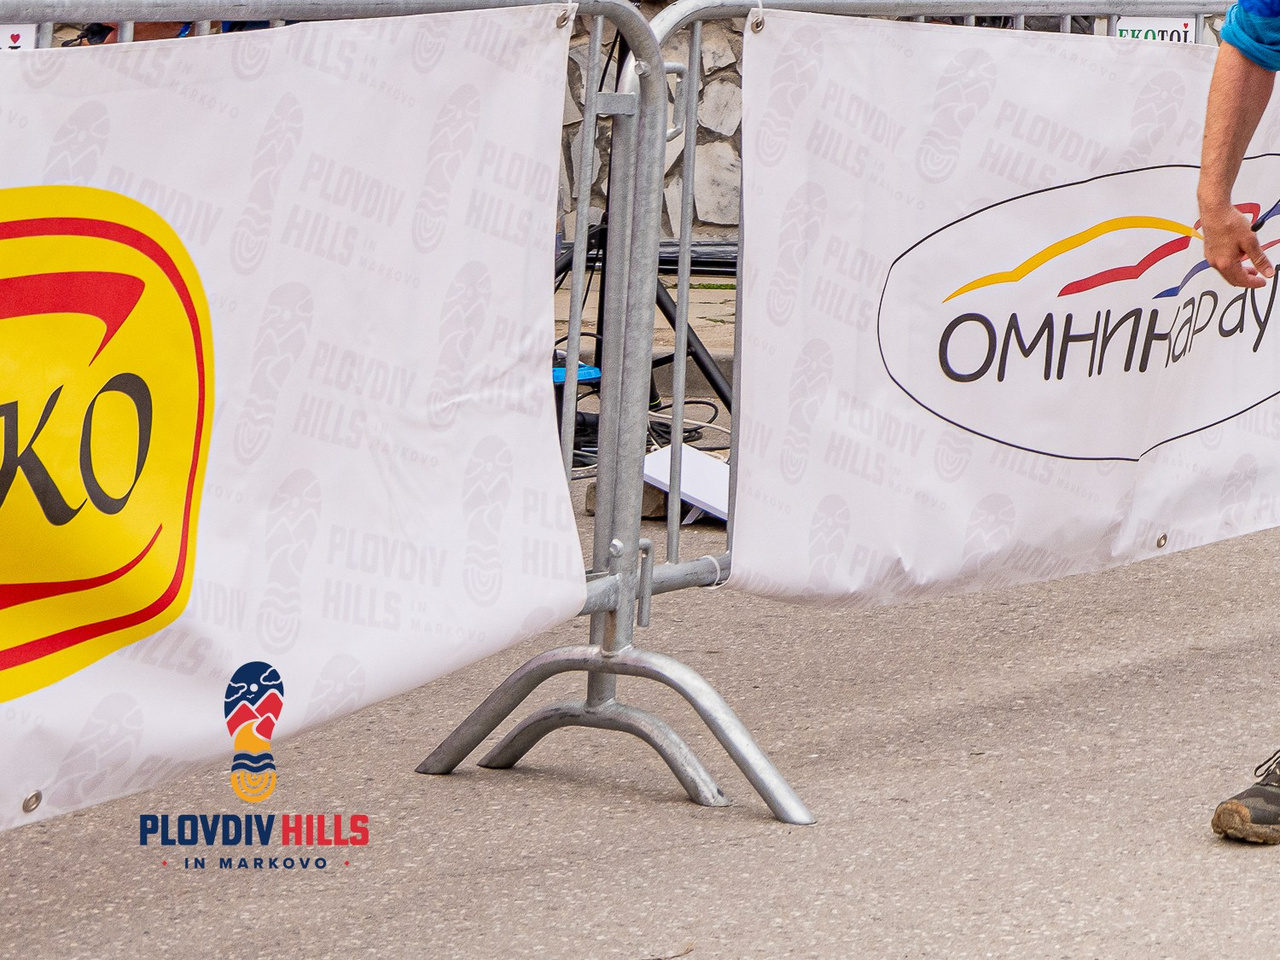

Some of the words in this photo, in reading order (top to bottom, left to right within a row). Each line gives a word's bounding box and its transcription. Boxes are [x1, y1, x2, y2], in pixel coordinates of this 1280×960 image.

[805, 118, 869, 179] HILLS
[978, 137, 1058, 191] HILLS
[994, 98, 1110, 174] PLOVDIV
[299, 151, 406, 228] PLOVDIV
[464, 187, 534, 248] HILLS
[281, 203, 359, 267] HILLS
[810, 275, 874, 333] HILLS
[307, 340, 417, 410] PLOVDIV
[292, 392, 368, 450] HILLS
[834, 389, 926, 458] PLOVDIV
[823, 430, 886, 486] HILLS
[326, 524, 449, 587] PLOVDIV
[321, 577, 401, 632] HILLS
